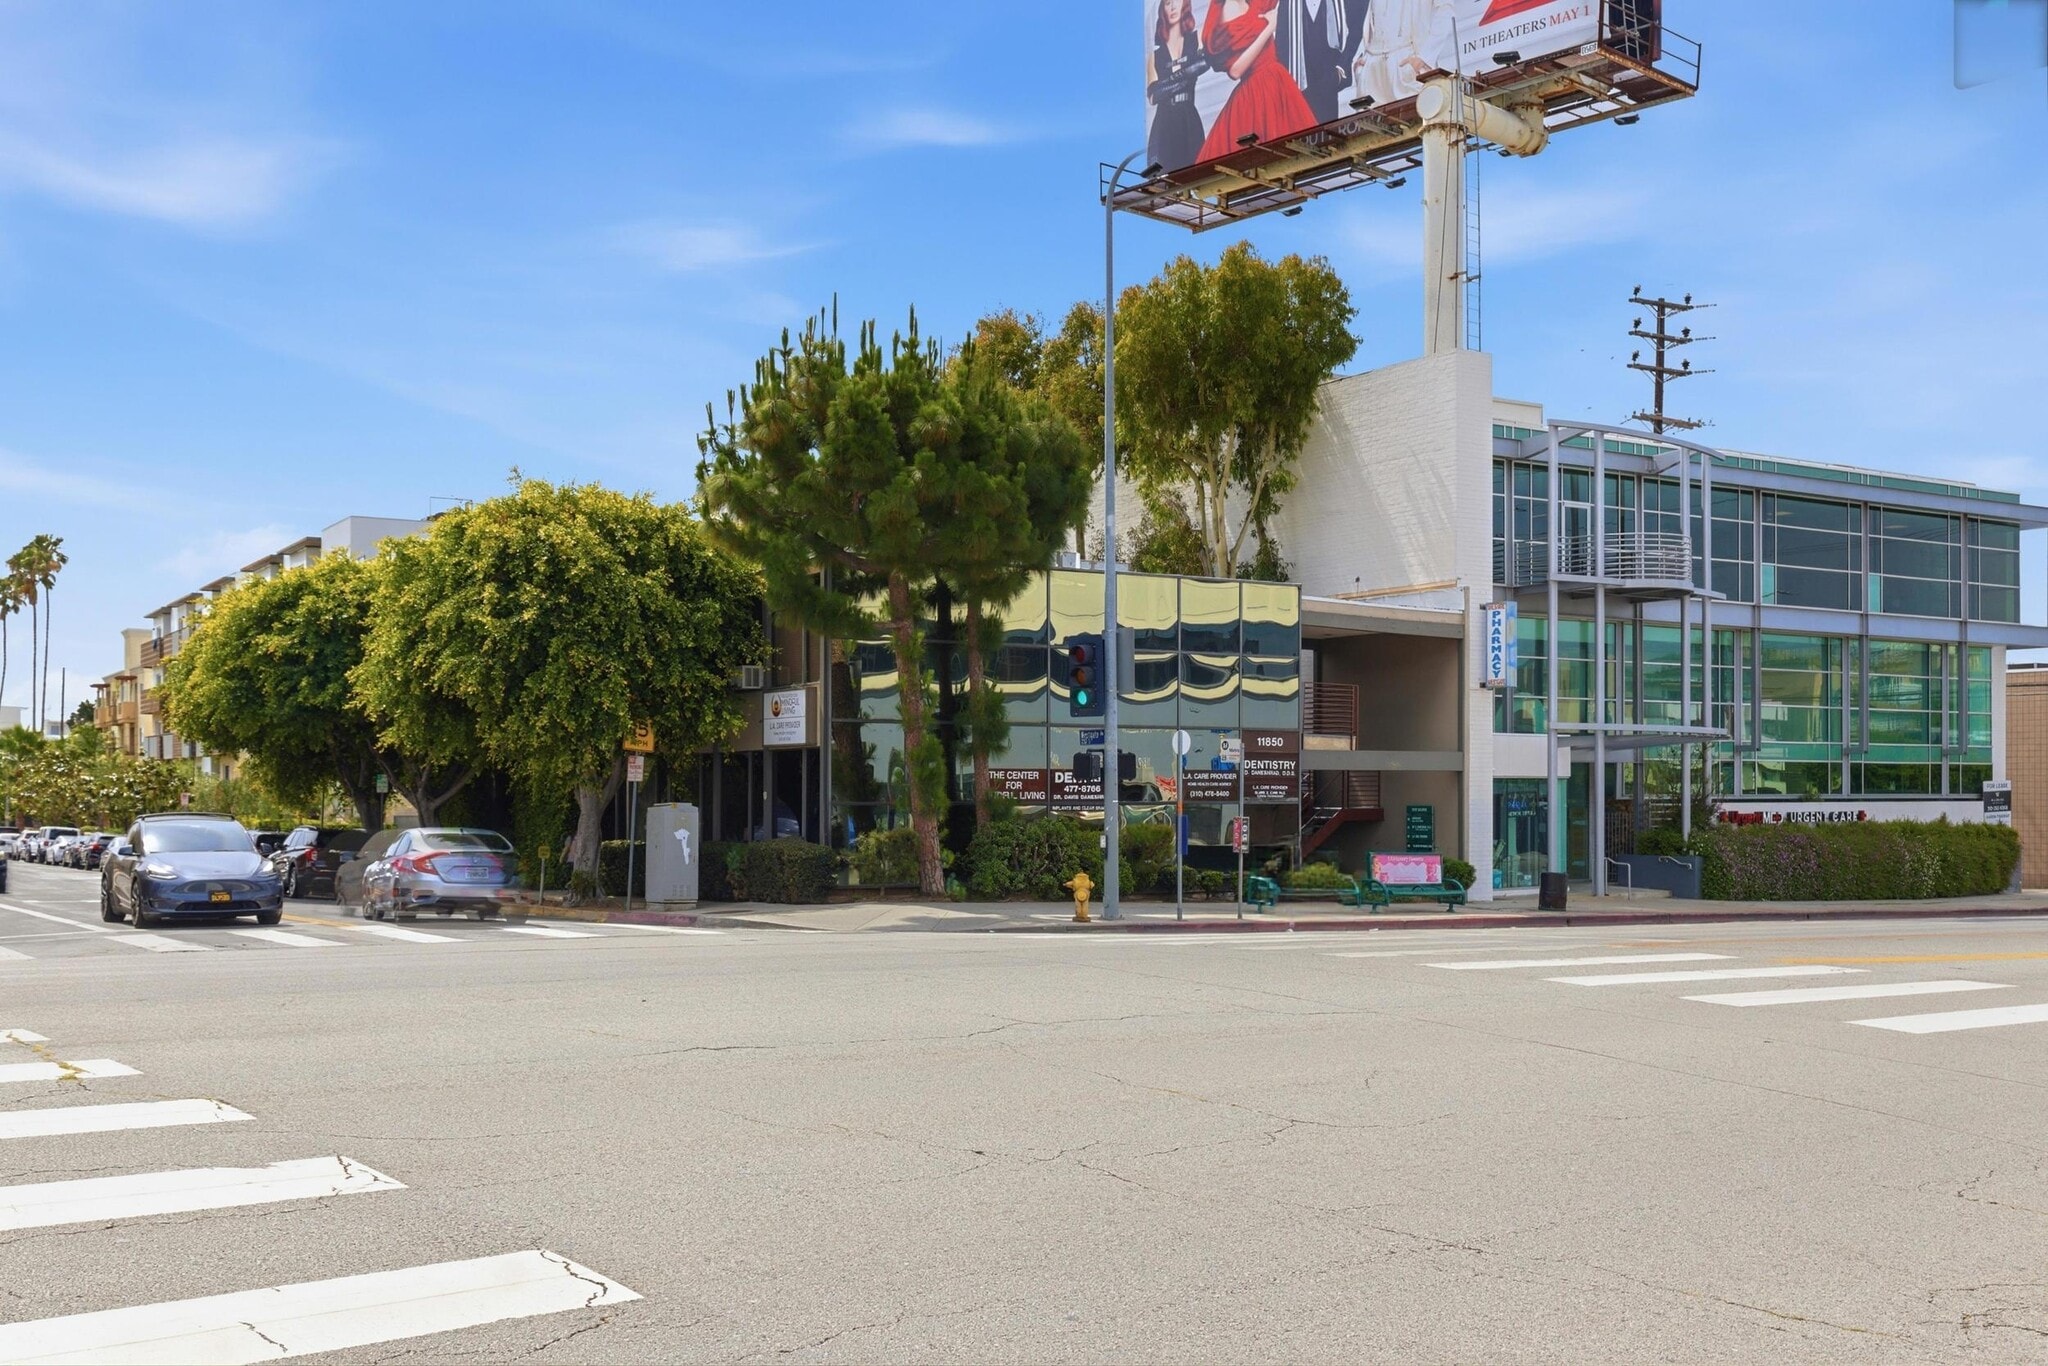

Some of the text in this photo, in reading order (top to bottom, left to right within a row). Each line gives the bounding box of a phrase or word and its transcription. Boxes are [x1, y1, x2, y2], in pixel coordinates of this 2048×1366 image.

[1463, 5, 1590, 54] IN THEATERS MAY 1
[1491, 610, 1502, 679] PHARMACY
[1256, 737, 1284, 747] 11850
[1244, 760, 1296, 770] DENTISTRY
[989, 771, 1039, 780] THE CENTER
[1005, 781, 1023, 790] FOR
[1020, 791, 1046, 800] LIVING
[1788, 811, 1826, 823] URGENT
[1831, 811, 1858, 822] CARE
